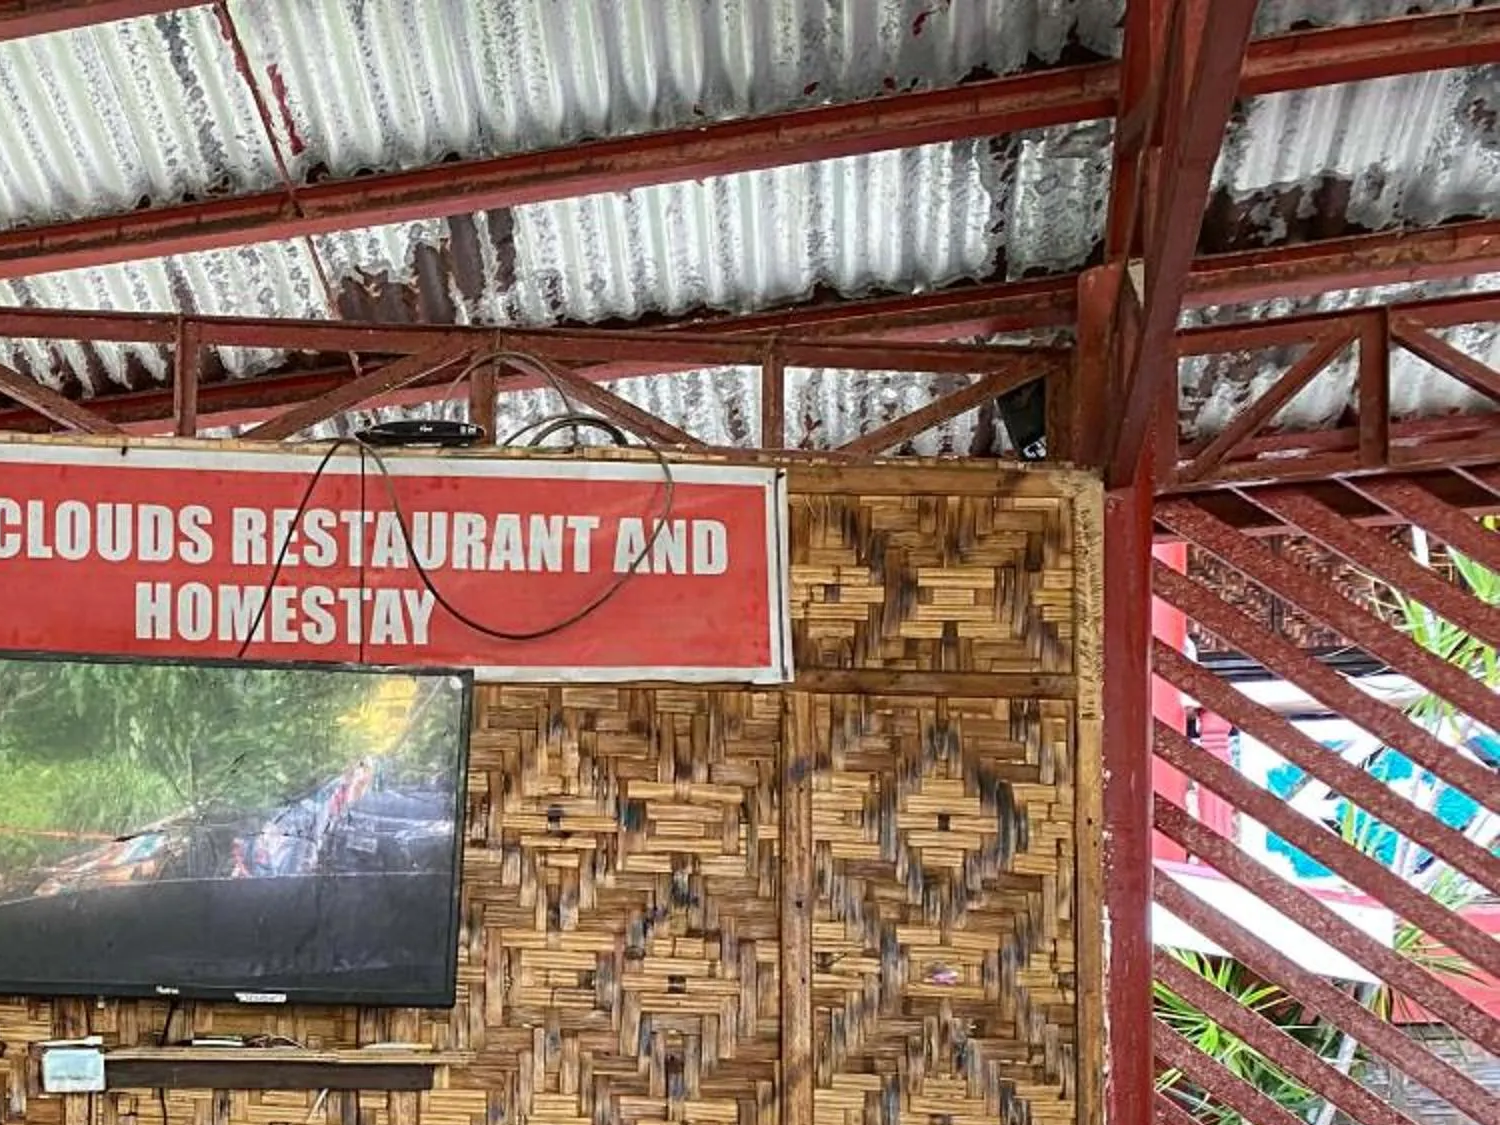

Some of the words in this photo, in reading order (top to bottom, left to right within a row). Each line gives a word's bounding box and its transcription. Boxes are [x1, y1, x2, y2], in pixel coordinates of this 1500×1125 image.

[231, 506, 600, 573] RESTAURANT
[612, 517, 728, 576] AND
[134, 581, 437, 647] HOMESTAY
